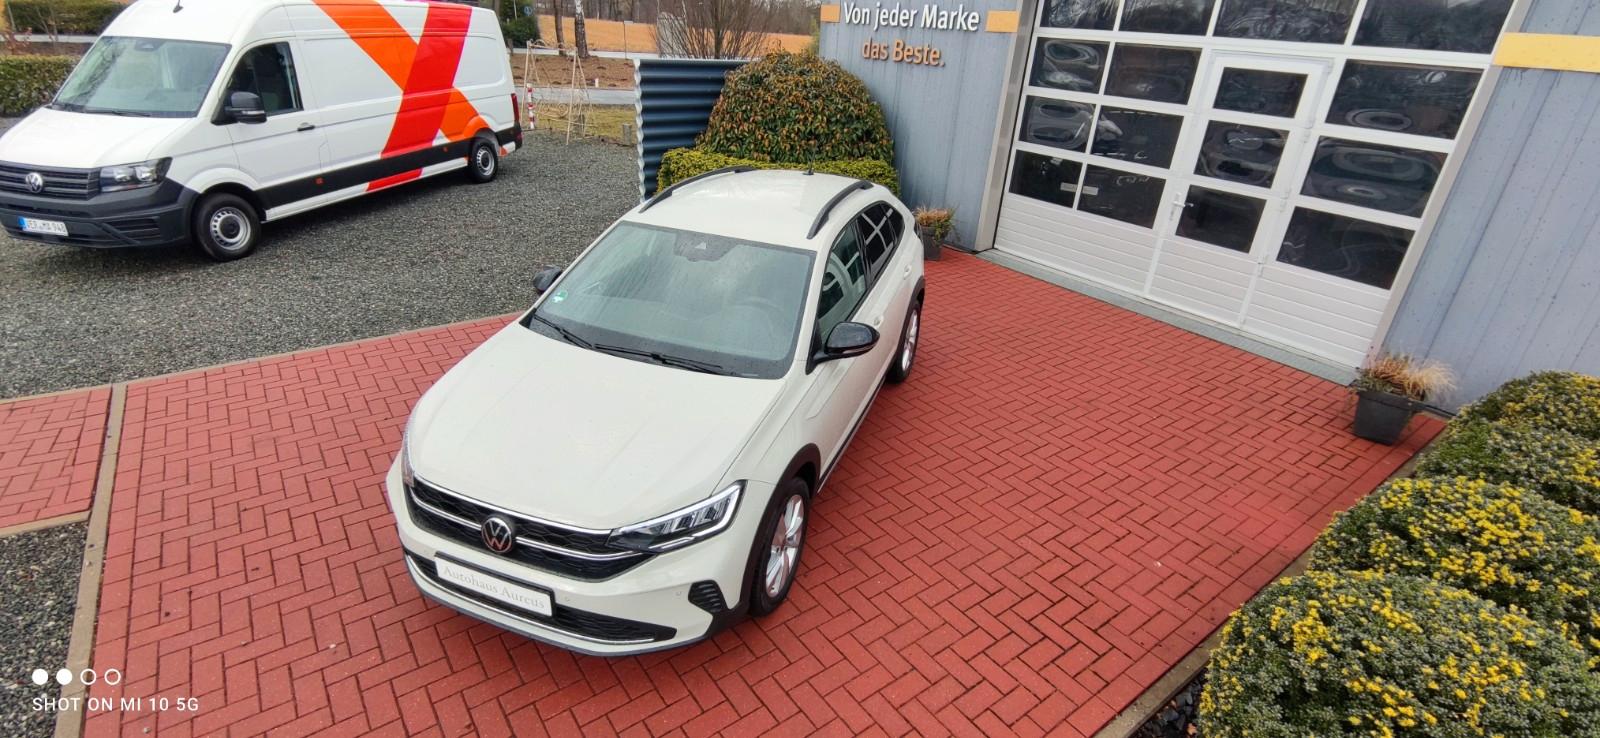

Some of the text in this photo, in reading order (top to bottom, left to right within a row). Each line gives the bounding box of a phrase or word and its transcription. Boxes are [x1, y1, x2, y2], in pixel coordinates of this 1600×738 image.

[843, 2, 980, 31] Von jeder Marke
[862, 37, 946, 67] das Beste.
[481, 516, 513, 552] VW
[443, 566, 547, 609] Autohaus Aureus
